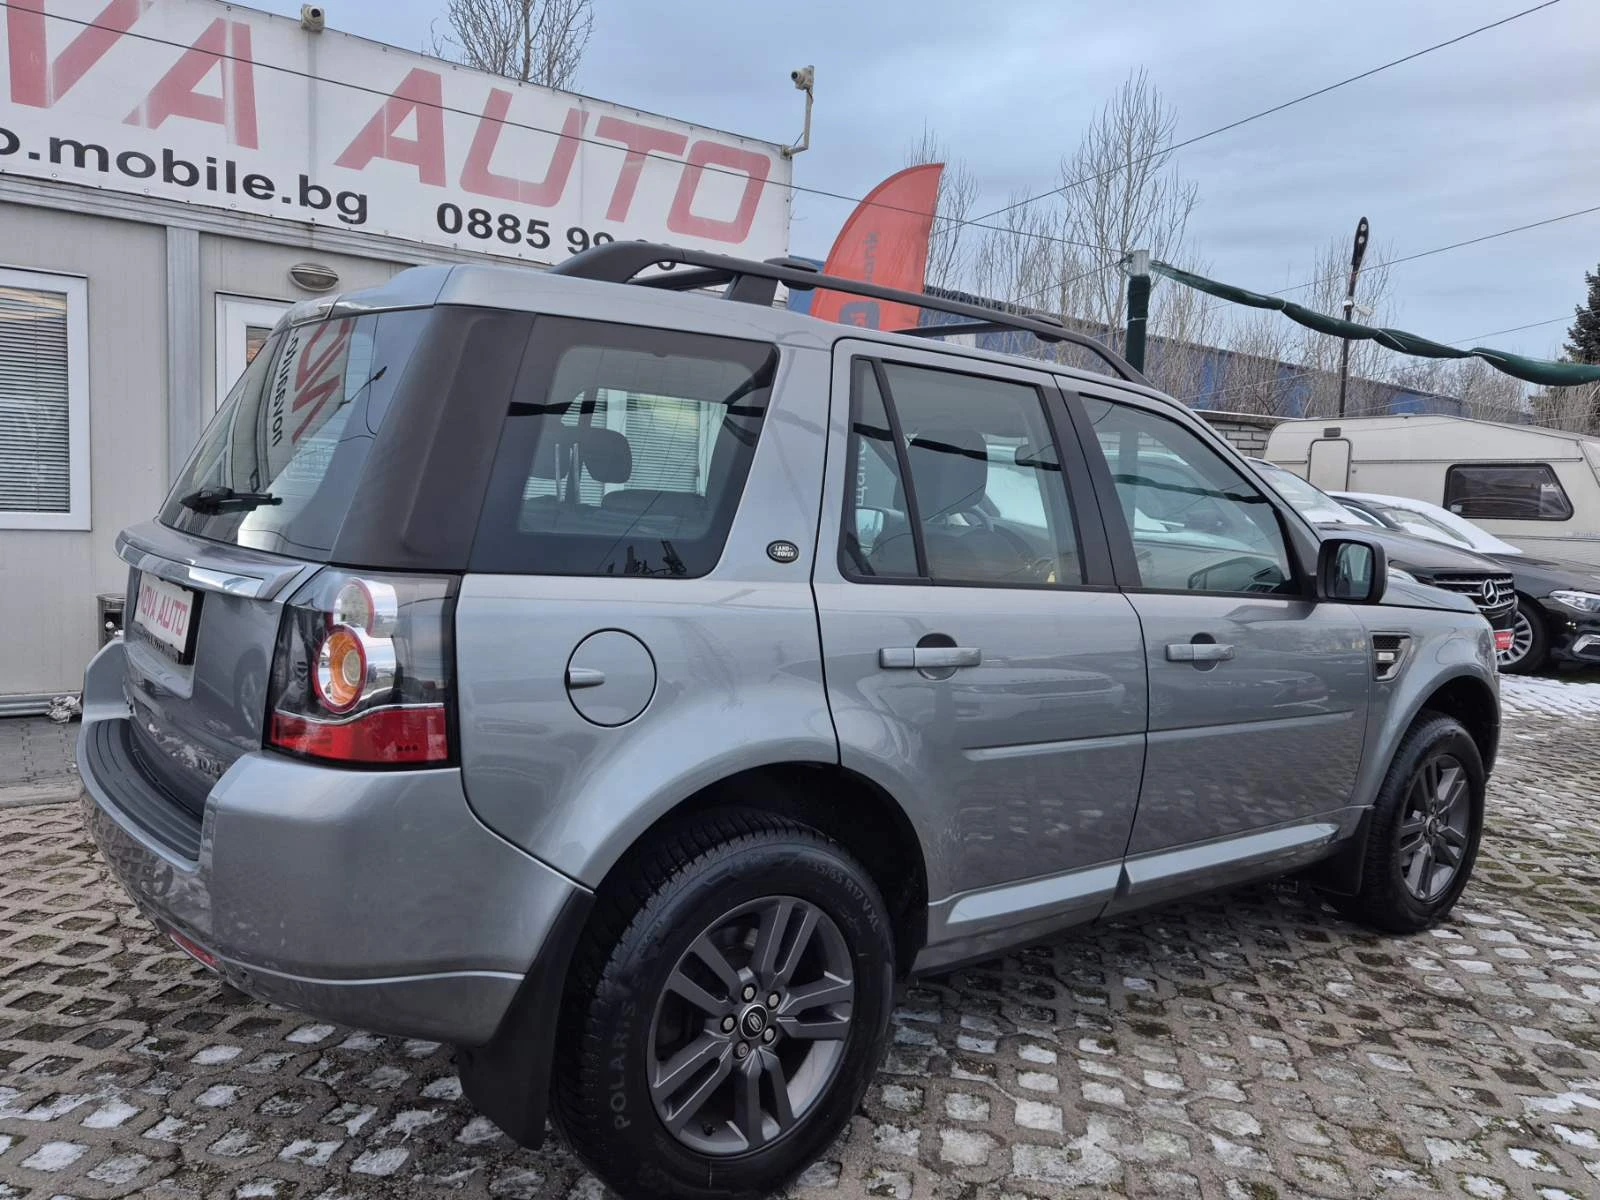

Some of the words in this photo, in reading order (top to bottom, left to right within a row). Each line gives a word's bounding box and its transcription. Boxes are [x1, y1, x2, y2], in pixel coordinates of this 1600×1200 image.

[333, 67, 771, 244] AUTO
[436, 202, 551, 250] 0885
[156, 594, 189, 637] AUTO
